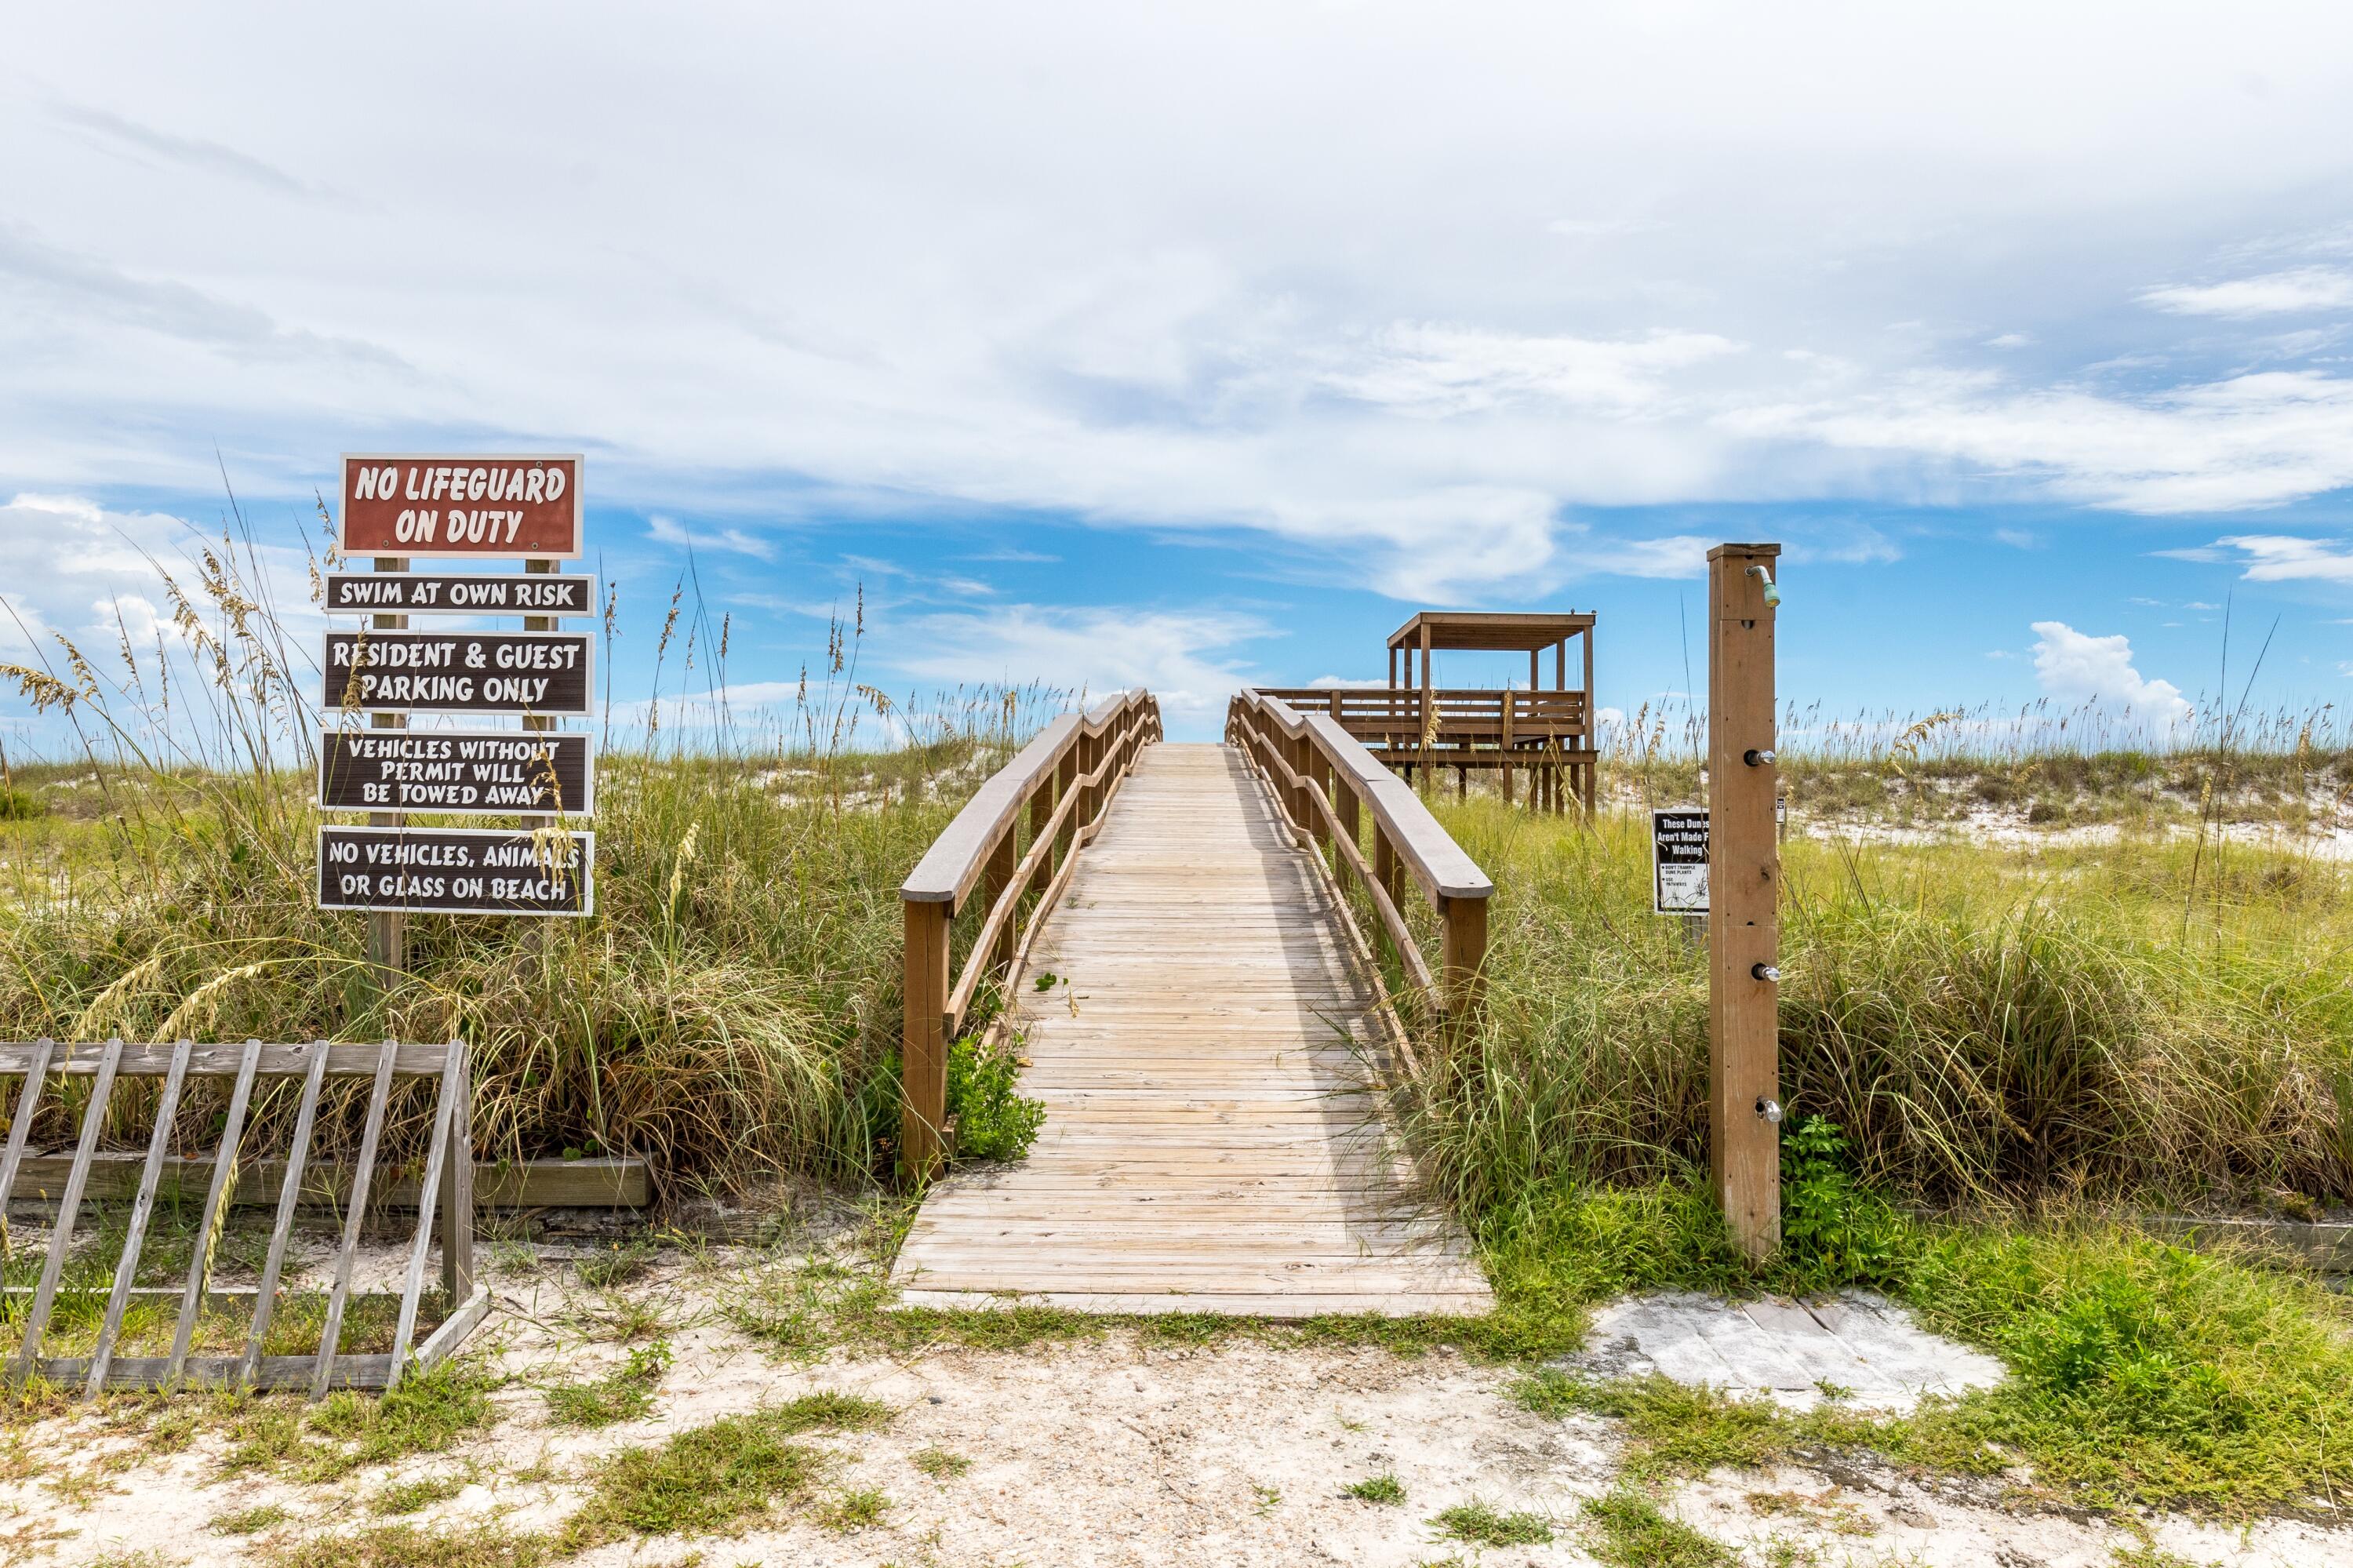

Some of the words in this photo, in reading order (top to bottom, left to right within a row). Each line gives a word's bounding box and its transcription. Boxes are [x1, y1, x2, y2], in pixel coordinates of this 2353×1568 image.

[355, 467, 398, 500] NO
[406, 467, 566, 504] LIFEGUARD
[395, 509, 438, 543] ON
[446, 510, 523, 544] DUTY
[340, 582, 403, 604] SWIM
[411, 582, 441, 605] AT
[449, 583, 507, 606] OWN
[515, 584, 574, 607] RISK
[333, 641, 456, 668] RESIDENT
[464, 642, 486, 668] &
[496, 643, 580, 670] GUEST
[361, 675, 474, 702] PARKING
[483, 677, 549, 703] ONLY
[348, 739, 451, 759] VEHICLES
[460, 740, 560, 761] WITHOUT
[380, 761, 465, 782] PERMIT
[473, 764, 526, 784] WILL
[362, 783, 391, 803] BE
[398, 784, 478, 805] TOWED
[485, 786, 544, 806] AWAY
[1663, 819, 1685, 828] These
[1657, 832, 1679, 842] Aren't
[1681, 832, 1702, 842] Made
[329, 842, 358, 863] NO
[365, 843, 474, 868] VEHICLES,
[1672, 845, 1703, 857] Walking
[341, 875, 371, 897] OR
[379, 875, 445, 898] GLASS
[453, 877, 483, 899] ON
[491, 877, 566, 901] BEACH
